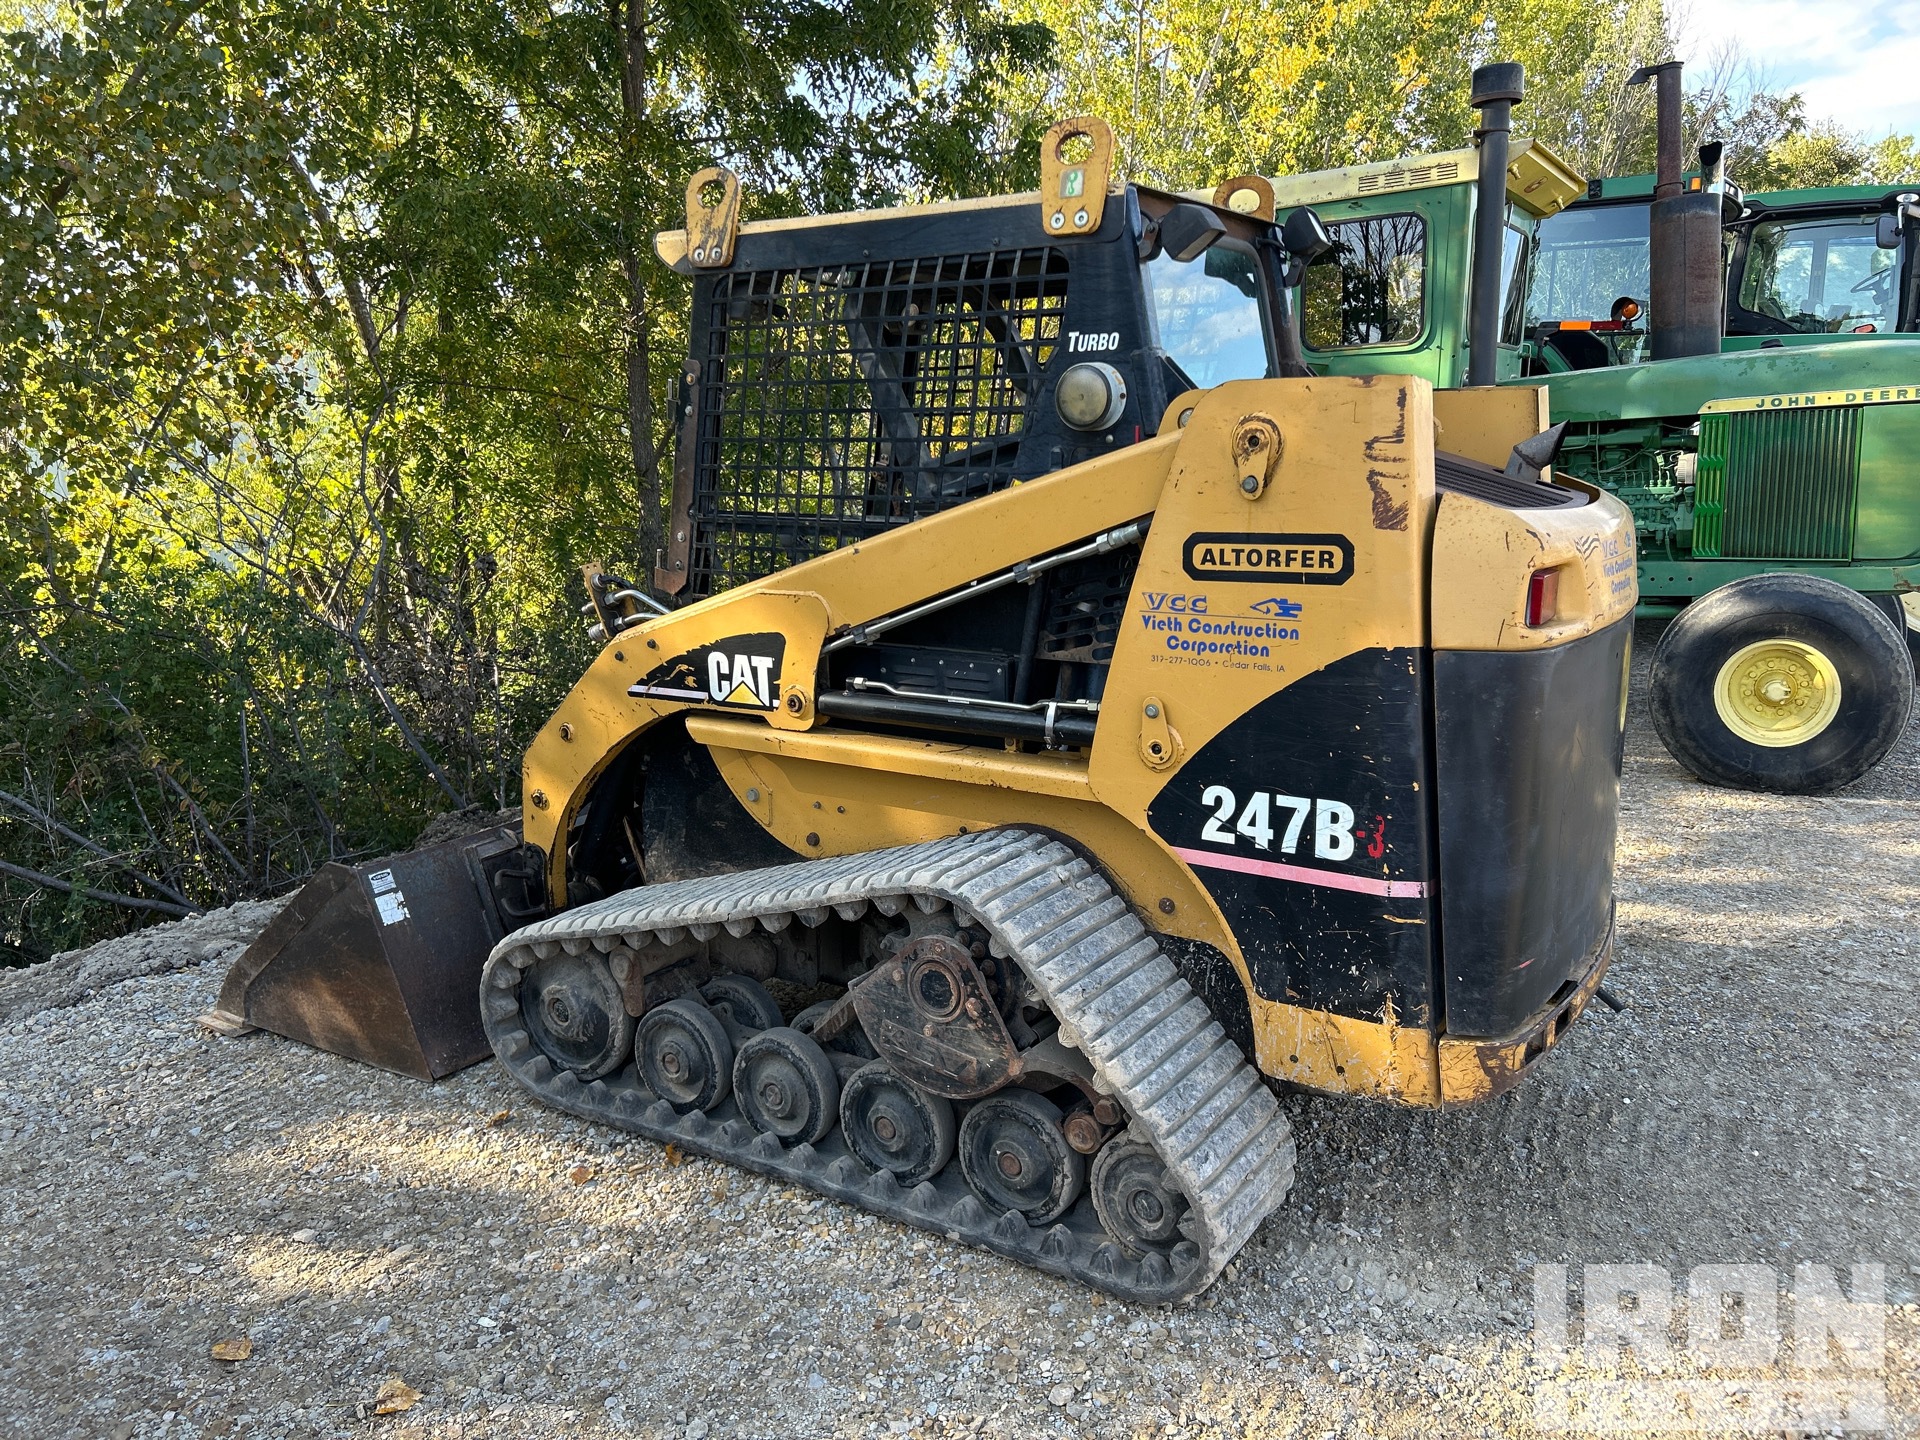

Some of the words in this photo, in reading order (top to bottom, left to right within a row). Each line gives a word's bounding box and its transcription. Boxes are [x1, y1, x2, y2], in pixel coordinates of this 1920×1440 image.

[1756, 396, 1816, 408] JOHN
[1200, 548, 1335, 568] ALTORFER
[1142, 592, 1208, 613] VCC
[1142, 614, 1183, 632] Vieth
[1188, 617, 1299, 640] Construction
[1166, 635, 1270, 657] Corporation
[1253, 662, 1273, 672] Falls,
[1276, 664, 1286, 672] IA
[707, 651, 774, 707] CAT
